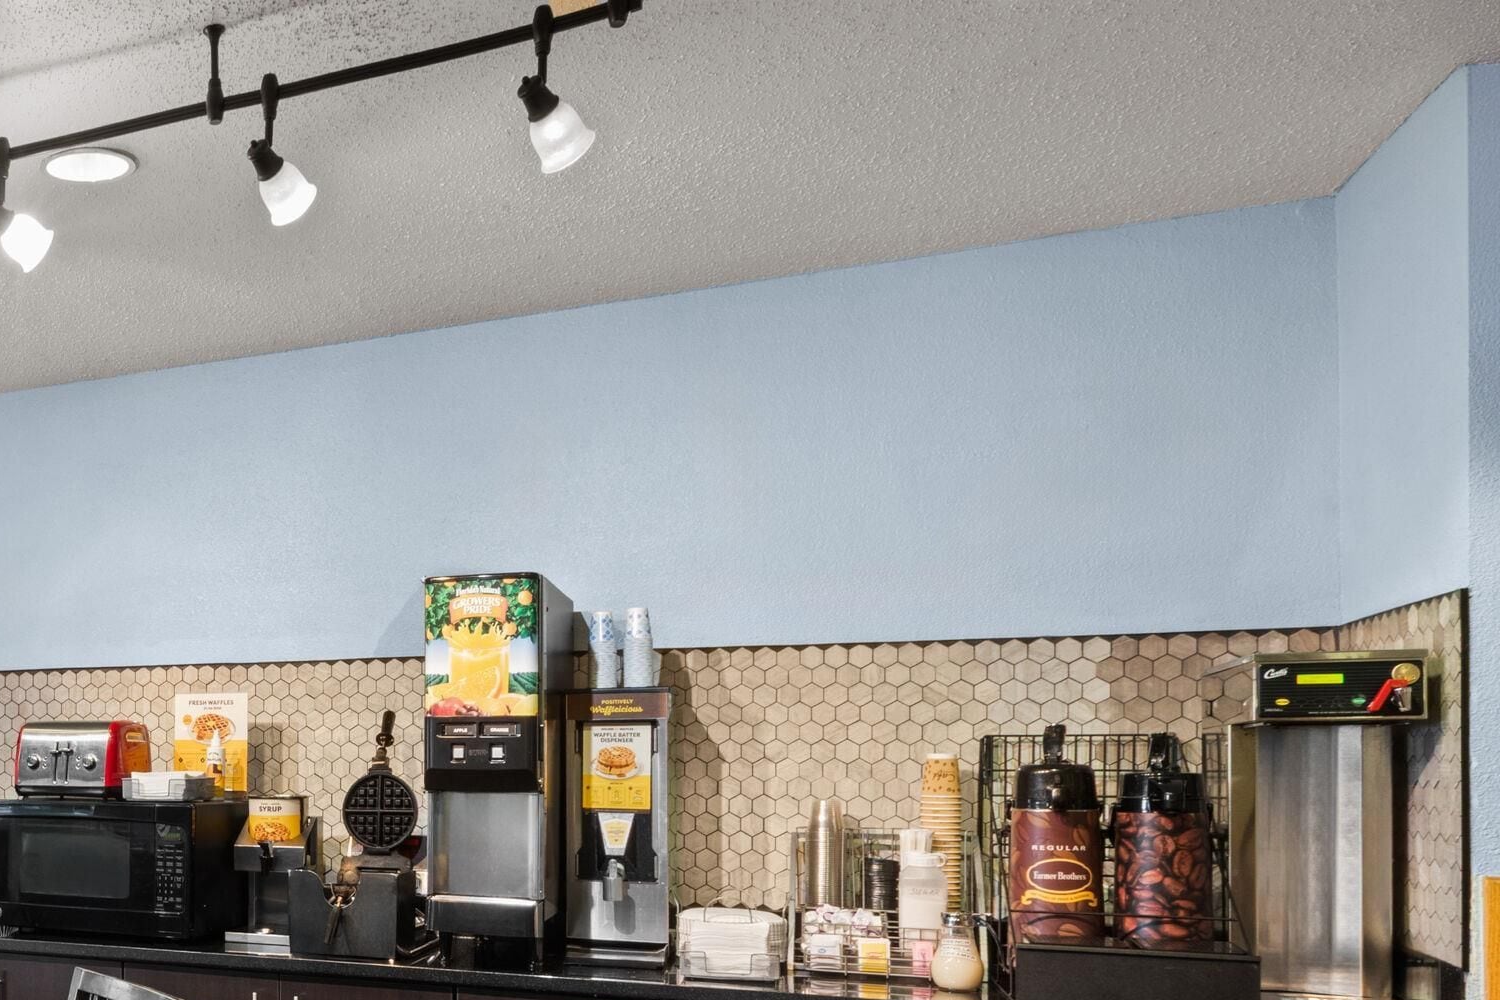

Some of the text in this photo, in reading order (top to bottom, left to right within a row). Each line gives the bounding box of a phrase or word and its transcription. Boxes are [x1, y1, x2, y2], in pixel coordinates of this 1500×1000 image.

[463, 605, 493, 615] PRIDE
[1033, 870, 1087, 881] Farmer Brothers
